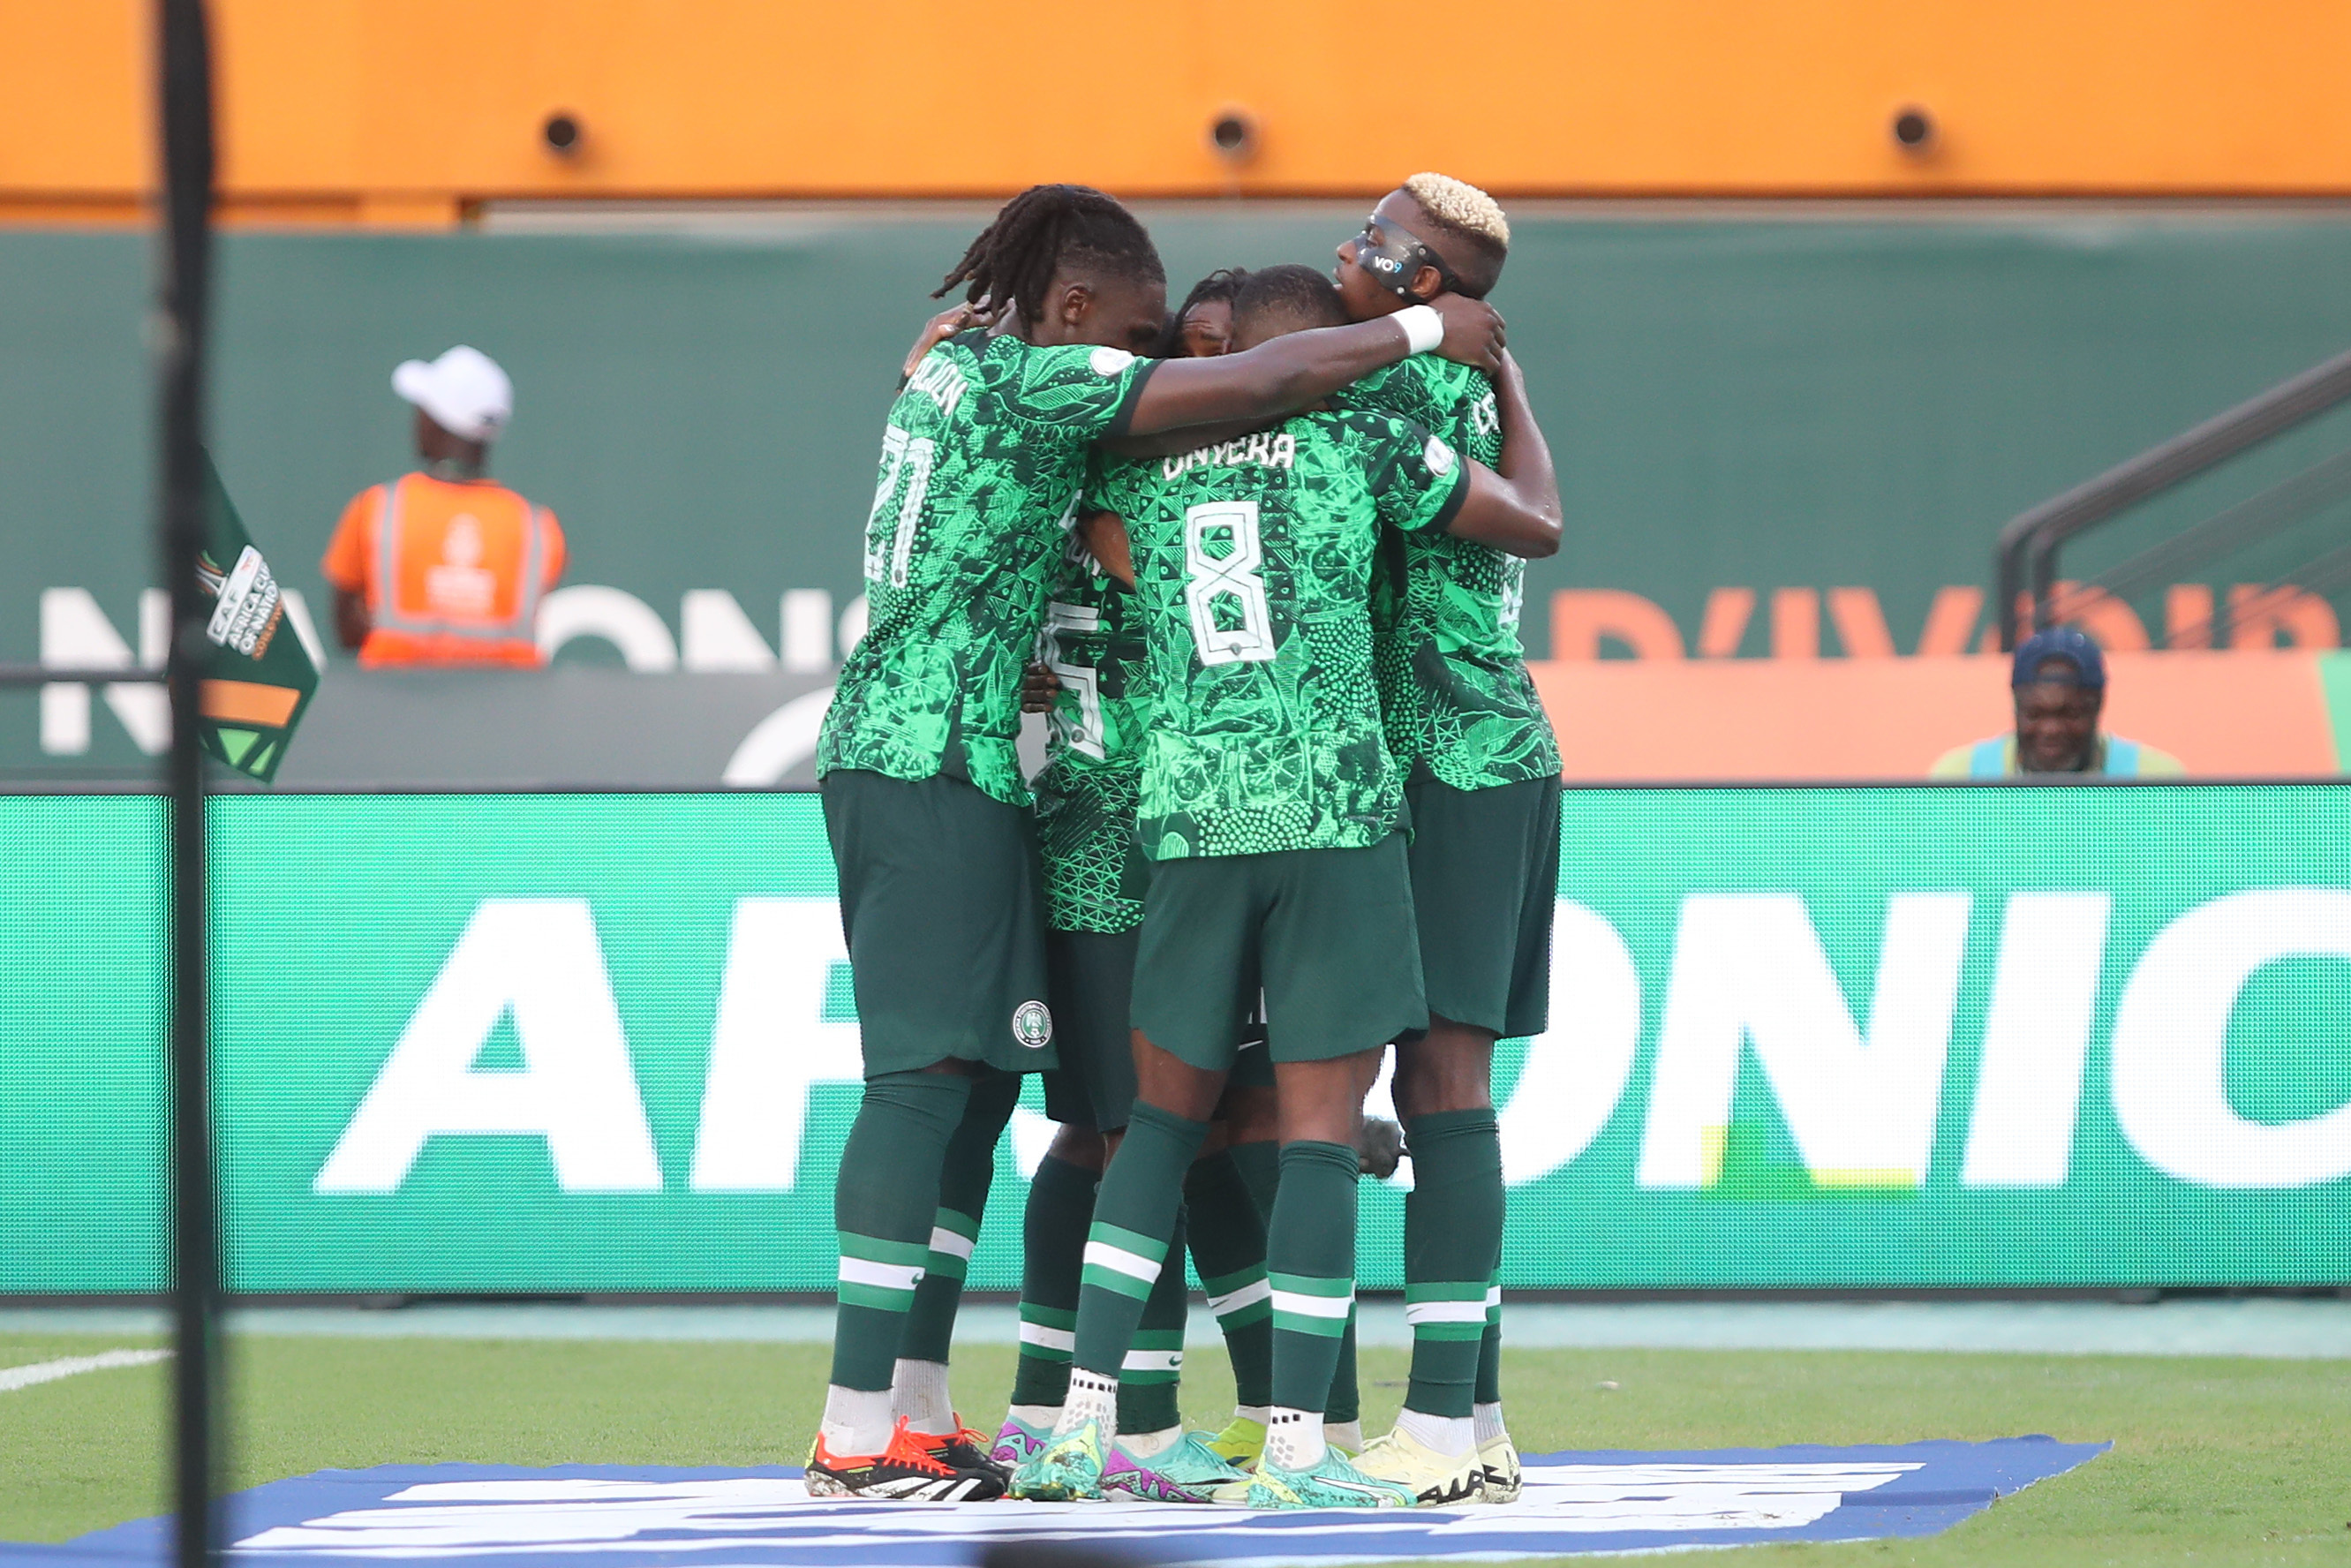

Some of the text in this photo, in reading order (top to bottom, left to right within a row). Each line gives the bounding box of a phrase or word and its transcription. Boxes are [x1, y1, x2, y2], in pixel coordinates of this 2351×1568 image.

[1374, 255, 1403, 274] VO9
[249, 578, 281, 636] NATIO
[1185, 501, 1277, 667] 8
